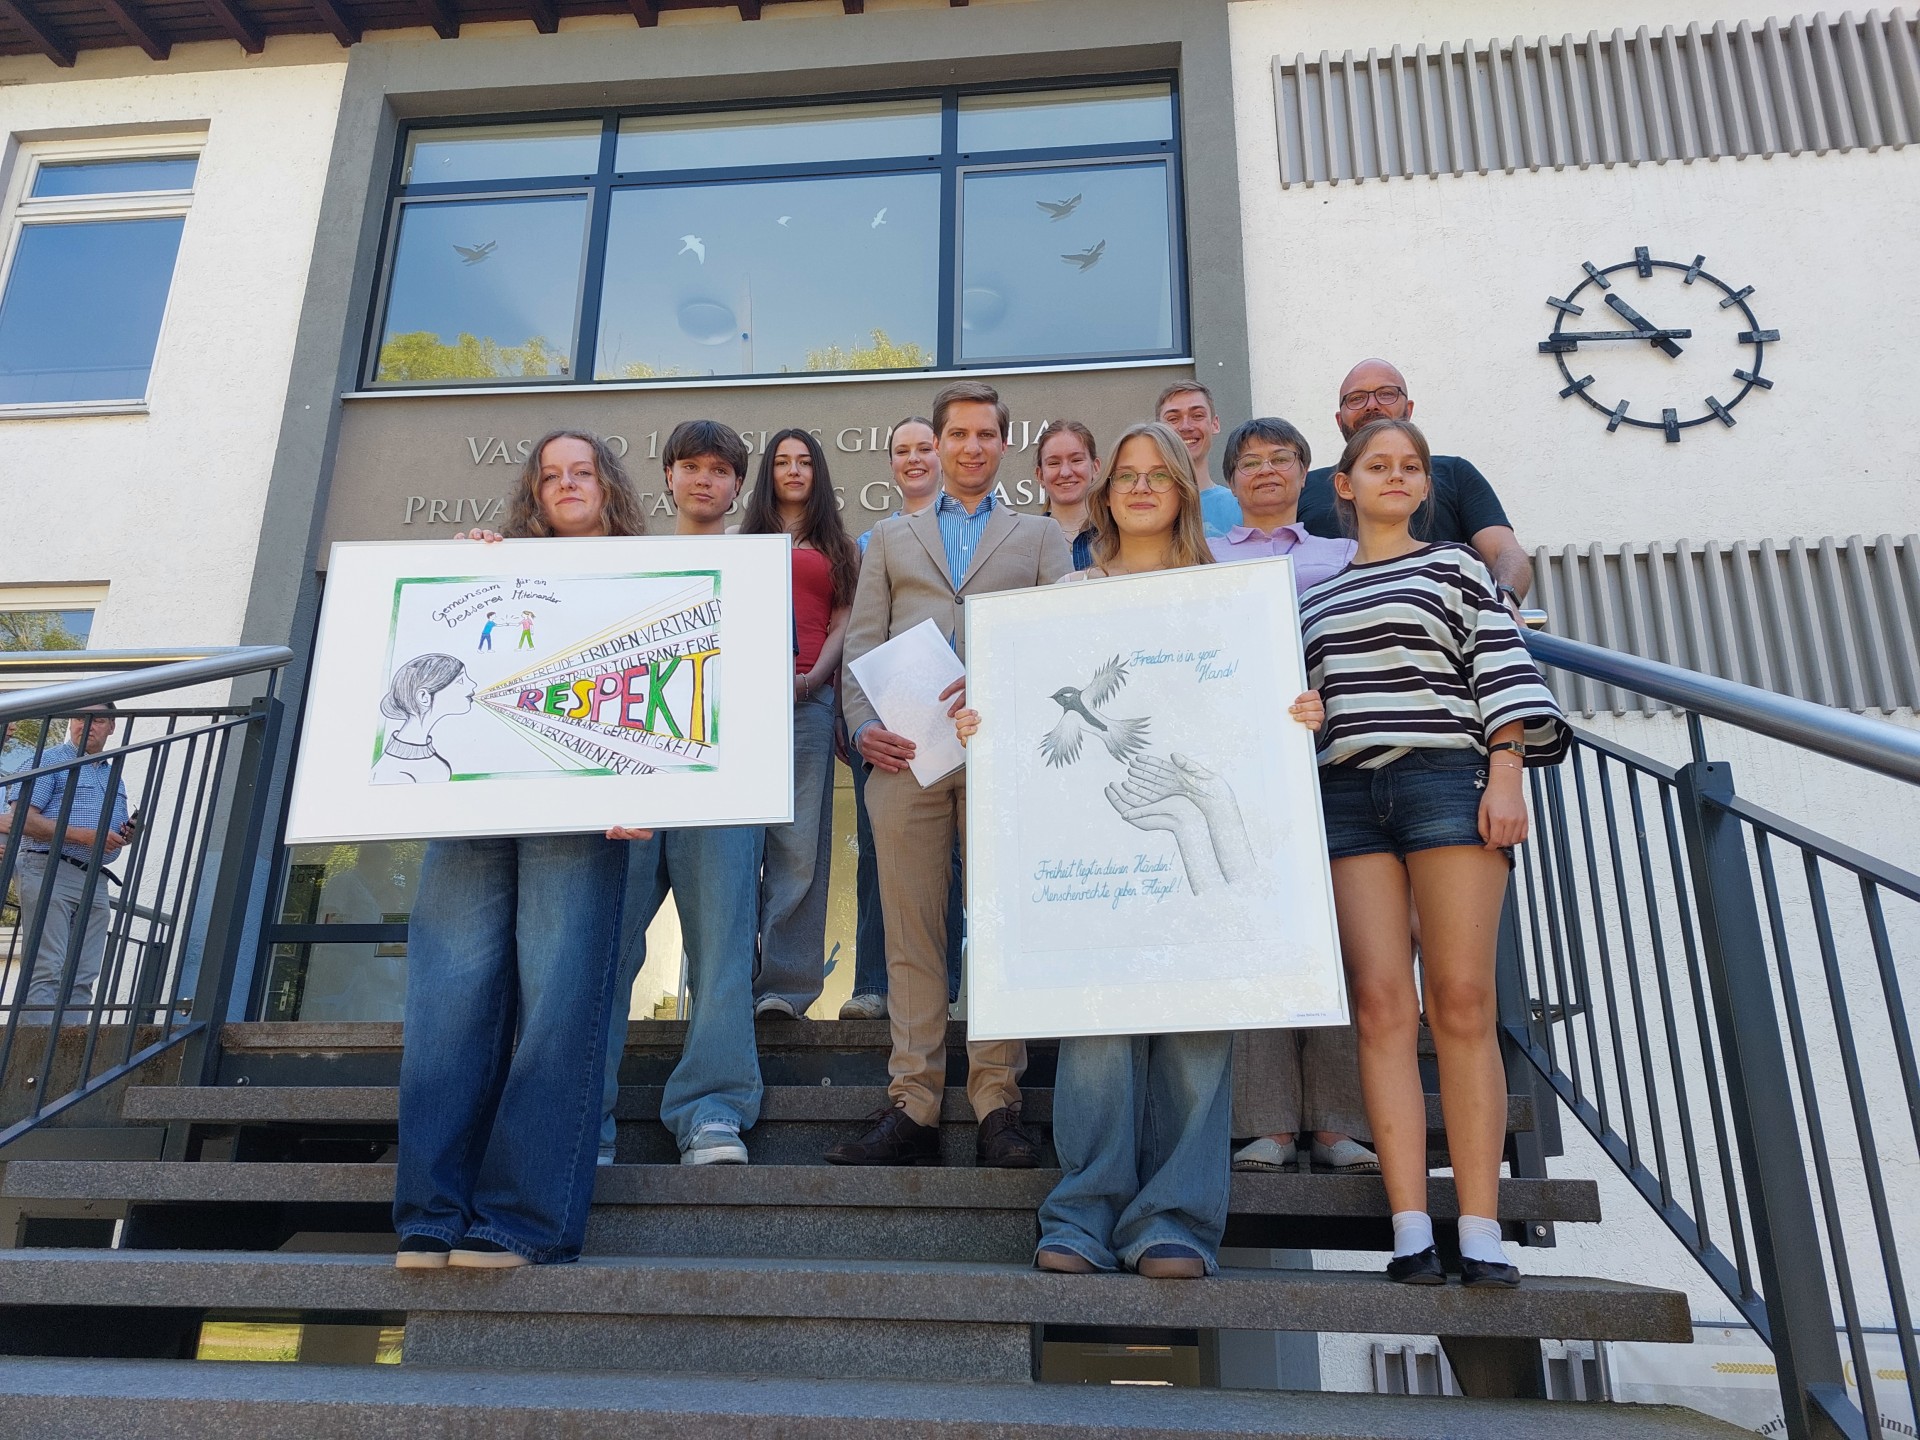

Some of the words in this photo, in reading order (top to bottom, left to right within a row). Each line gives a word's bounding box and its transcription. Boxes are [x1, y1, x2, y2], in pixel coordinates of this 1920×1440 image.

[466, 434, 629, 465] VASO
[432, 584, 501, 621] Gemeinsam
[515, 578, 531, 588] für
[445, 595, 503, 628] besseres
[511, 590, 561, 604] Miteinander
[533, 657, 576, 678] FREUDE
[580, 631, 640, 663] FRIEDEN
[548, 664, 608, 685] VERTRAUEN
[611, 643, 680, 672] TOLERANZ
[1130, 649, 1174, 667] Freedom
[1176, 650, 1185, 663] is
[1185, 650, 1195, 662] in
[1195, 649, 1221, 672] your
[517, 648, 721, 743] RESPEKT
[539, 724, 606, 763] VERTRAUEN
[558, 716, 601, 732] TOLERANZ
[603, 724, 712, 758] GERECHTIGKEIT
[1033, 858, 1076, 881] Freiheit
[1075, 858, 1096, 885] liegt
[1093, 861, 1103, 875] in
[1103, 857, 1128, 875] deinen
[1133, 851, 1176, 874] Händen!
[1032, 882, 1110, 903] Menschenrechte
[1112, 881, 1137, 910] geben
[1141, 876, 1183, 904] Flügel!
